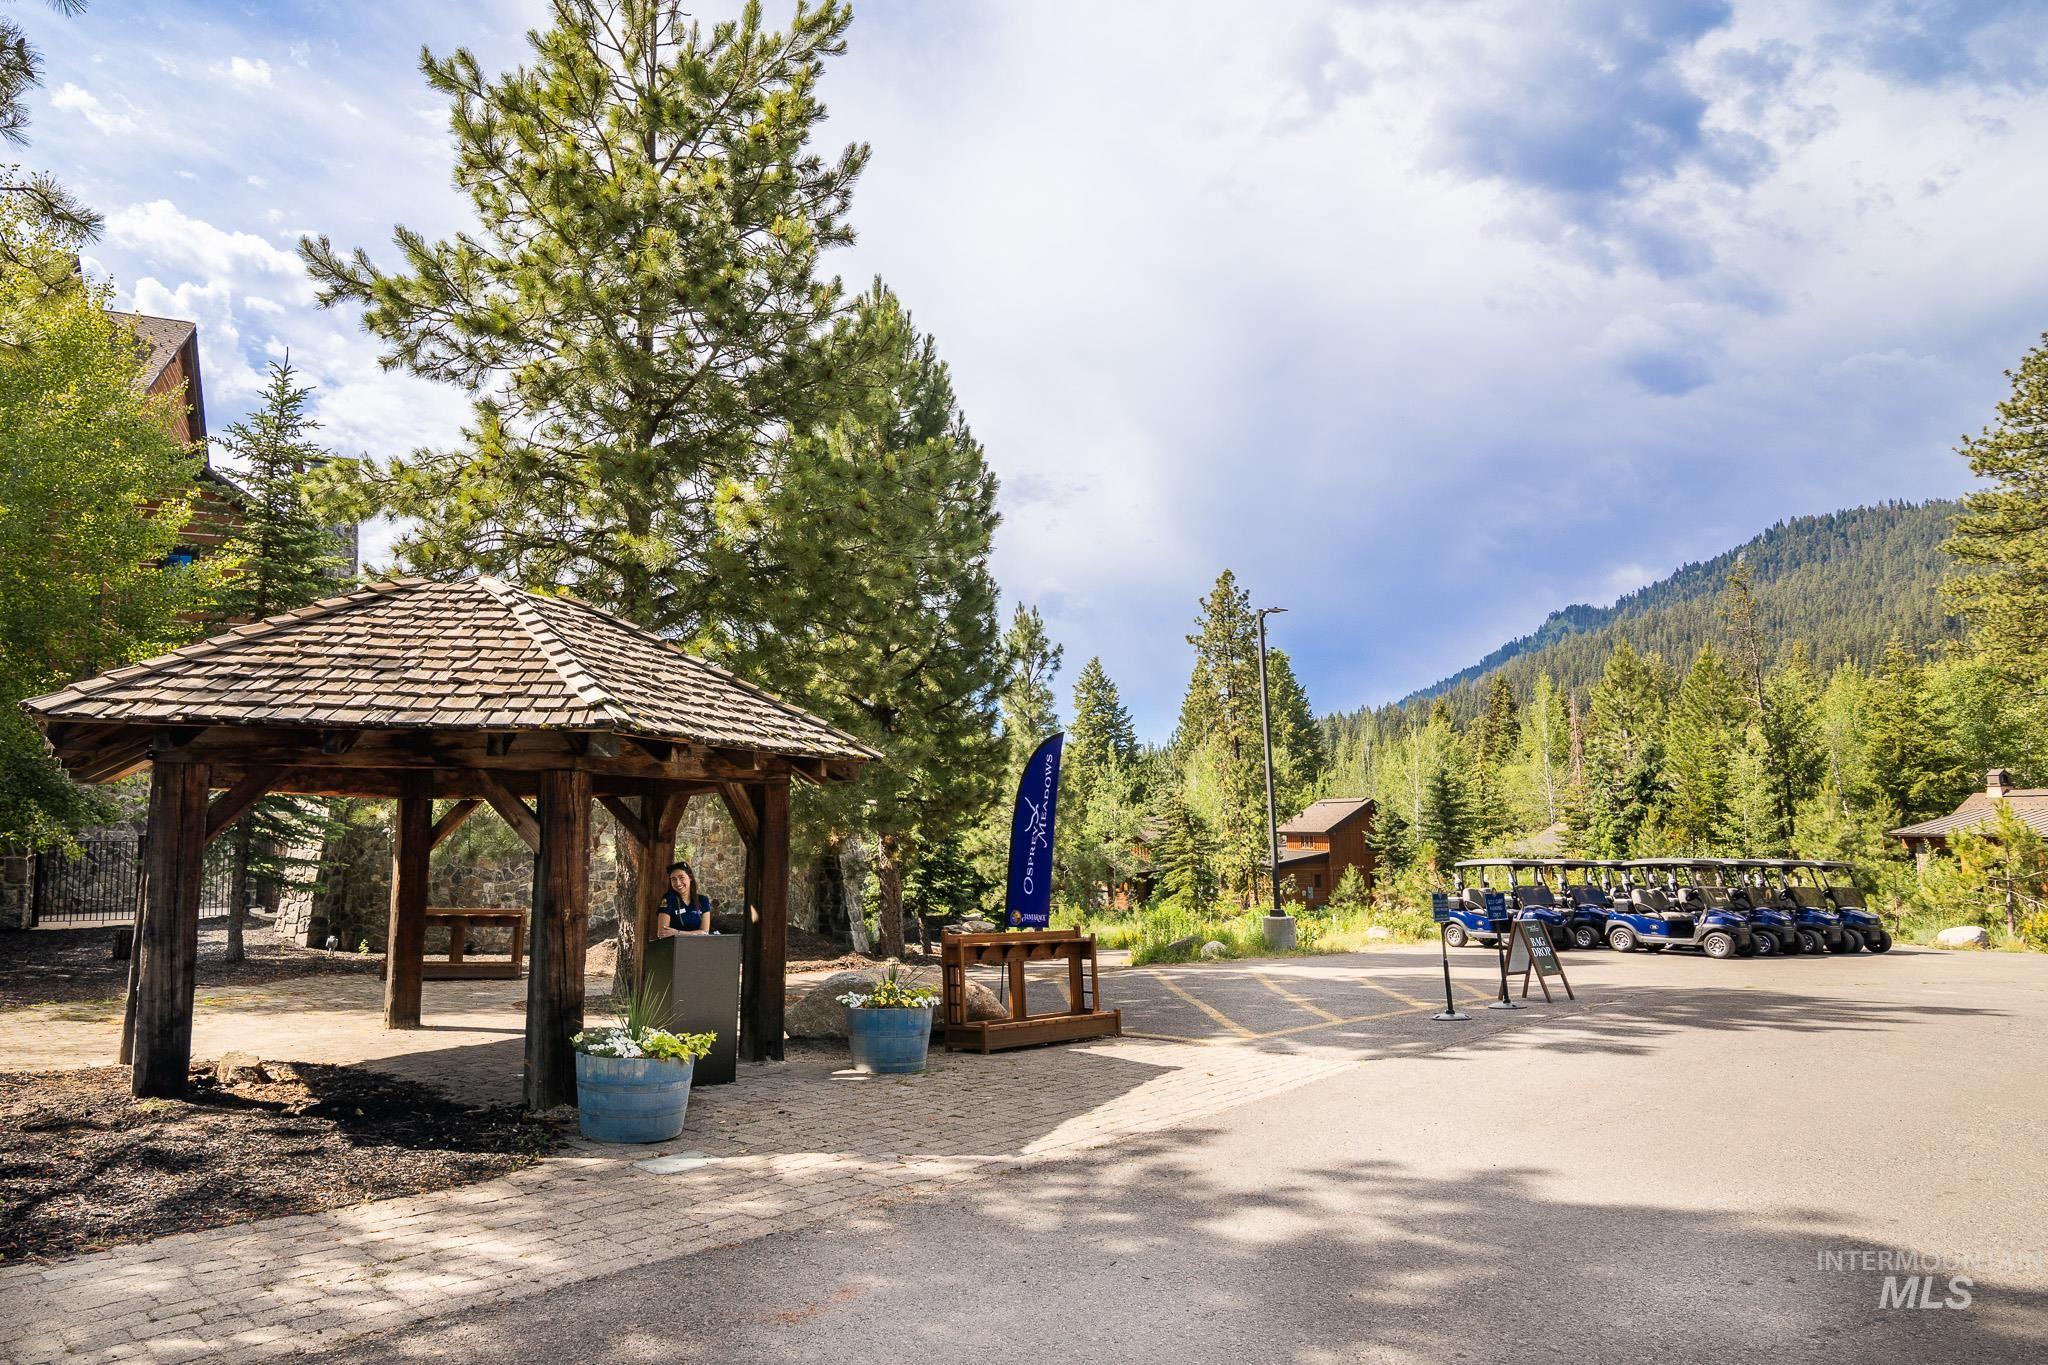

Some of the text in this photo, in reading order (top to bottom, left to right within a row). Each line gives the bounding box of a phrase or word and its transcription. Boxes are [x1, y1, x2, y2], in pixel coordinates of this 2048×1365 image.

[1037, 753, 1053, 848] MEADOWS
[1023, 826, 1039, 895] OSPREY
[1530, 937, 1545, 947] BAG
[1531, 947, 1551, 957] DROP
